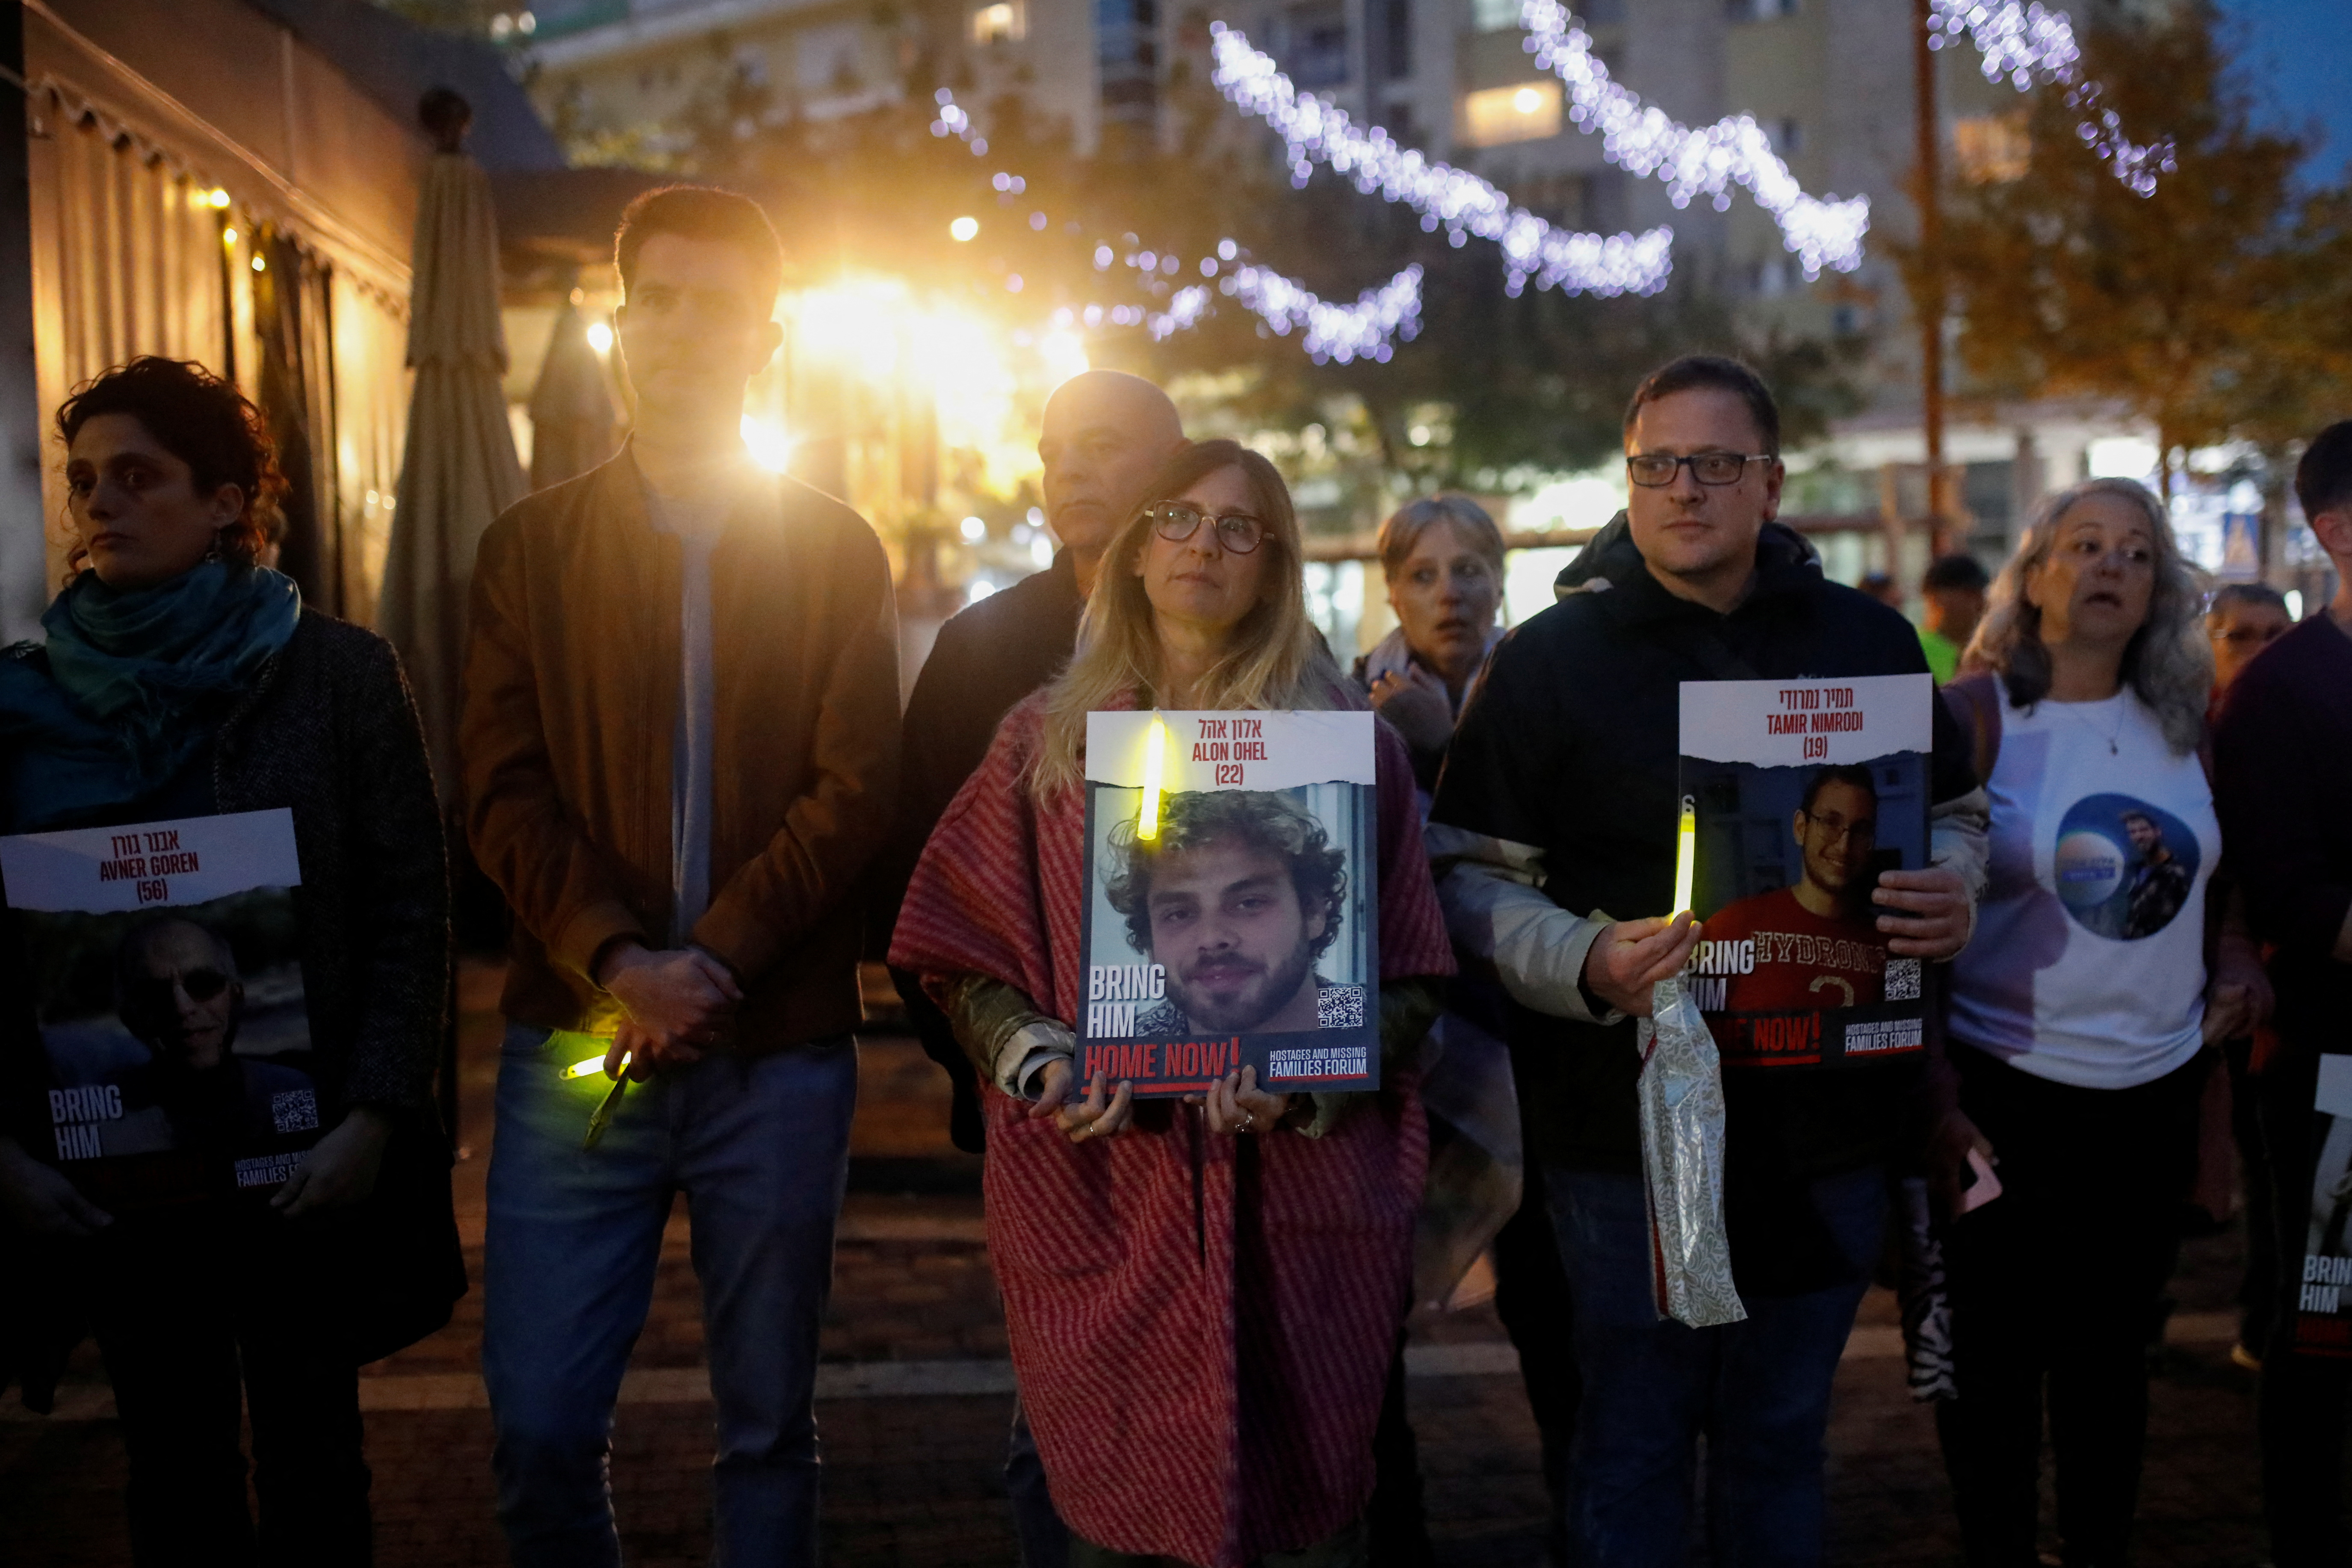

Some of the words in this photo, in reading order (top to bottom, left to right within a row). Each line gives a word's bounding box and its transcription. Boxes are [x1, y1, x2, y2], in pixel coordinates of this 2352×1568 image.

[1780, 689, 1820, 710] נמרודי
[1823, 688, 1853, 709] תמיר
[1198, 719, 1227, 739] אהל
[1232, 718, 1262, 740] אלון
[1767, 713, 1807, 735] TAMIR
[1811, 711, 1863, 733] NIMRODI
[1192, 742, 1229, 761] ALON
[1234, 742, 1268, 760] OHEL
[1804, 735, 1828, 760] (19)
[1215, 763, 1244, 786] (22)
[111, 834, 141, 858] גורן
[143, 830, 180, 852] אבנר
[101, 858, 147, 881] AVNER
[150, 852, 198, 876] GOREN
[137, 878, 168, 904] (56)
[1089, 964, 1165, 1000] BRING
[1087, 1003, 1135, 1038] HIM
[1754, 1012, 1820, 1051] NOW!
[1845, 1033, 1888, 1052] FAMILIES
[1889, 1029, 1923, 1048] FORUM
[1084, 1044, 1158, 1080] HOME
[1165, 1036, 1240, 1077] NOW!
[1270, 1049, 1311, 1061] HOSTAGES
[1312, 1048, 1328, 1059] AND
[1330, 1047, 1366, 1059] MISSING
[1270, 1060, 1322, 1077] FAMILIES
[1325, 1058, 1367, 1075] FORUM
[48, 1084, 123, 1123] BRING
[54, 1124, 102, 1161] HIM
[234, 1155, 274, 1171] HOSTAGES
[275, 1153, 291, 1166] AND
[236, 1165, 287, 1188] FAMILIES
[2303, 1254, 2352, 1285] BRIN
[2299, 1283, 2339, 1314] HIM
